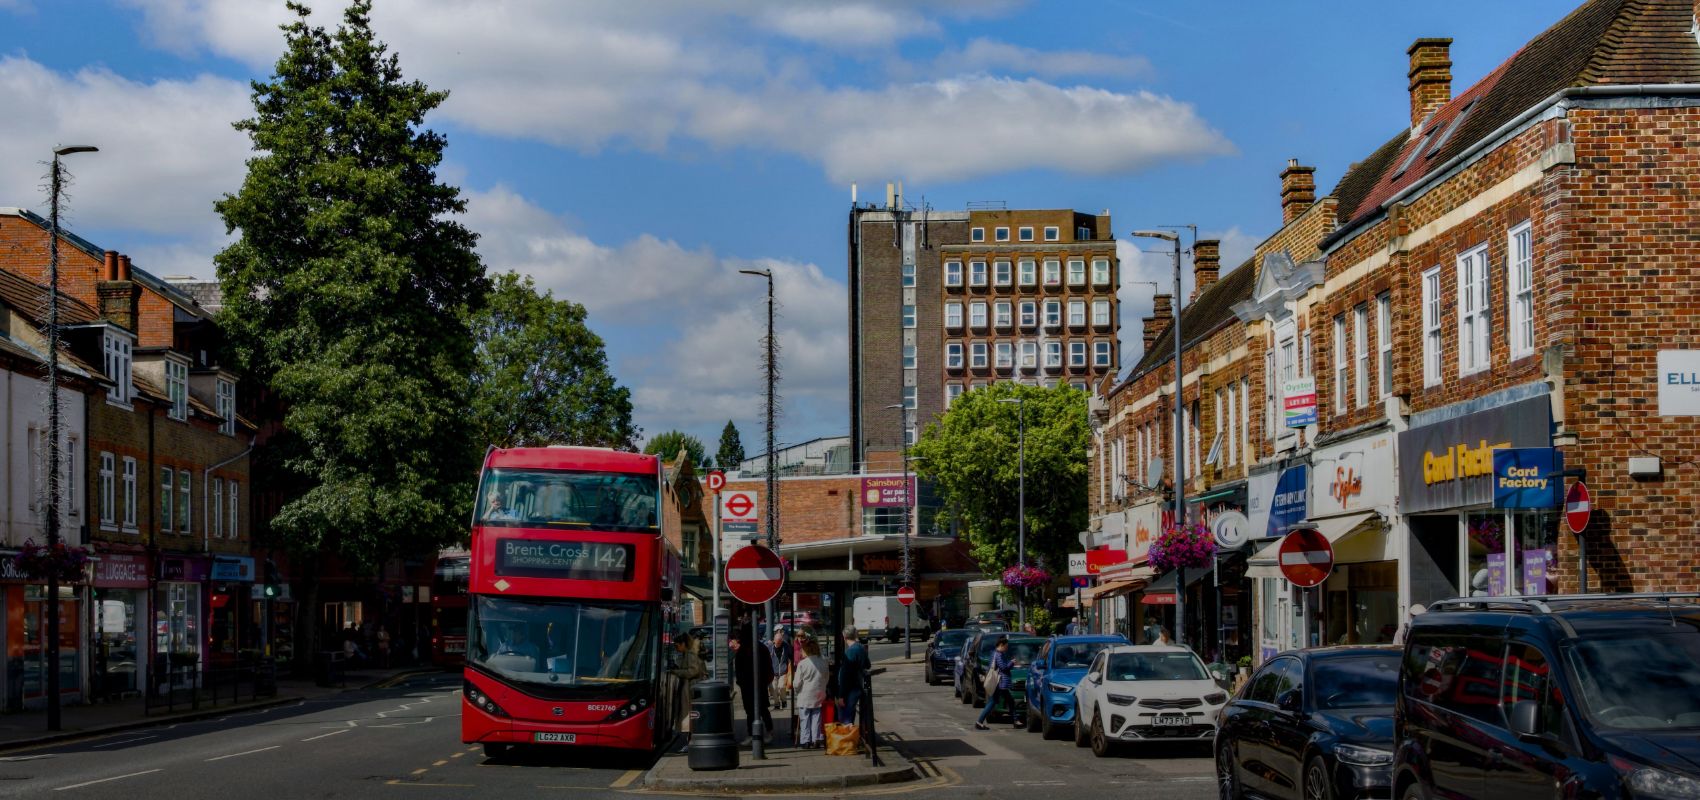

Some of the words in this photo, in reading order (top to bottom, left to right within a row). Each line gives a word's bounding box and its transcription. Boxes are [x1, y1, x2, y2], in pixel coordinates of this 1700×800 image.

[1286, 382, 1312, 391] Oyster
[1424, 446, 1455, 485] Card
[1456, 439, 1512, 478] Facto
[1507, 466, 1538, 477] Card
[709, 475, 723, 488] D
[866, 479, 910, 487] Sainsburys
[1499, 477, 1548, 490] Factory
[505, 542, 544, 555] Brent
[549, 544, 590, 558] Cross
[593, 546, 627, 568] 142
[105, 563, 136, 581] LUGGAGE
[539, 733, 559, 741] LG22
